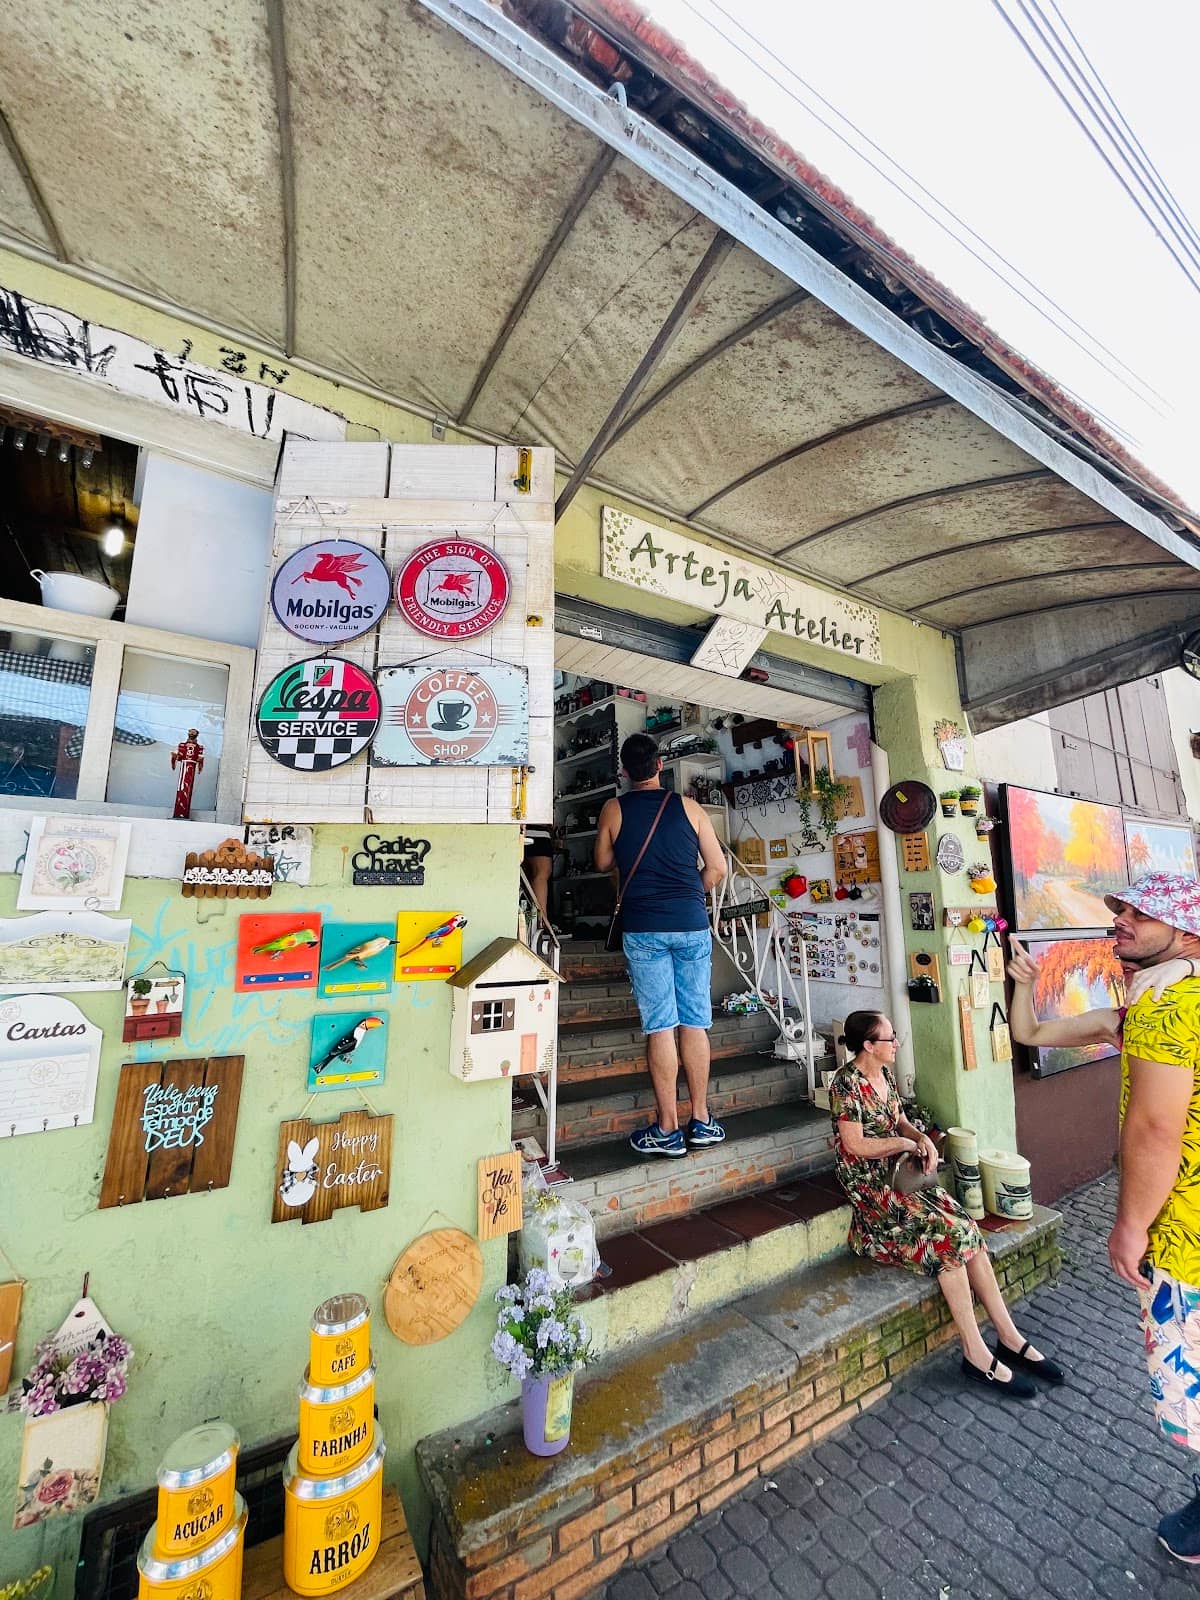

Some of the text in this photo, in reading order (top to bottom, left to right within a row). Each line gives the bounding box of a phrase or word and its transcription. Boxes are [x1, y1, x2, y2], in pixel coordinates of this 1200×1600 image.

[417, 545, 495, 568] THE SIGN OF
[629, 532, 754, 608] Arteja
[286, 598, 374, 623] Mobilgas
[404, 596, 501, 634] FRIENDLY SERVICE
[430, 597, 476, 609] Mobilgas
[765, 599, 865, 654] Atelier
[271, 670, 372, 720] Vespa
[416, 673, 489, 705] COFFEE
[276, 721, 359, 737] SERVICE
[433, 744, 469, 757] SHOP
[6, 1022, 87, 1041] Cartas
[144, 1117, 213, 1153] DEUS
[331, 1131, 378, 1156] Happy
[323, 1160, 384, 1189] Easter
[486, 1168, 513, 1190] Vai
[482, 1182, 518, 1204] COM
[492, 1198, 509, 1225] fé
[331, 1350, 357, 1373] CAFÉ
[313, 1420, 367, 1457] FARINHA
[309, 1521, 370, 1575] ARROZ
